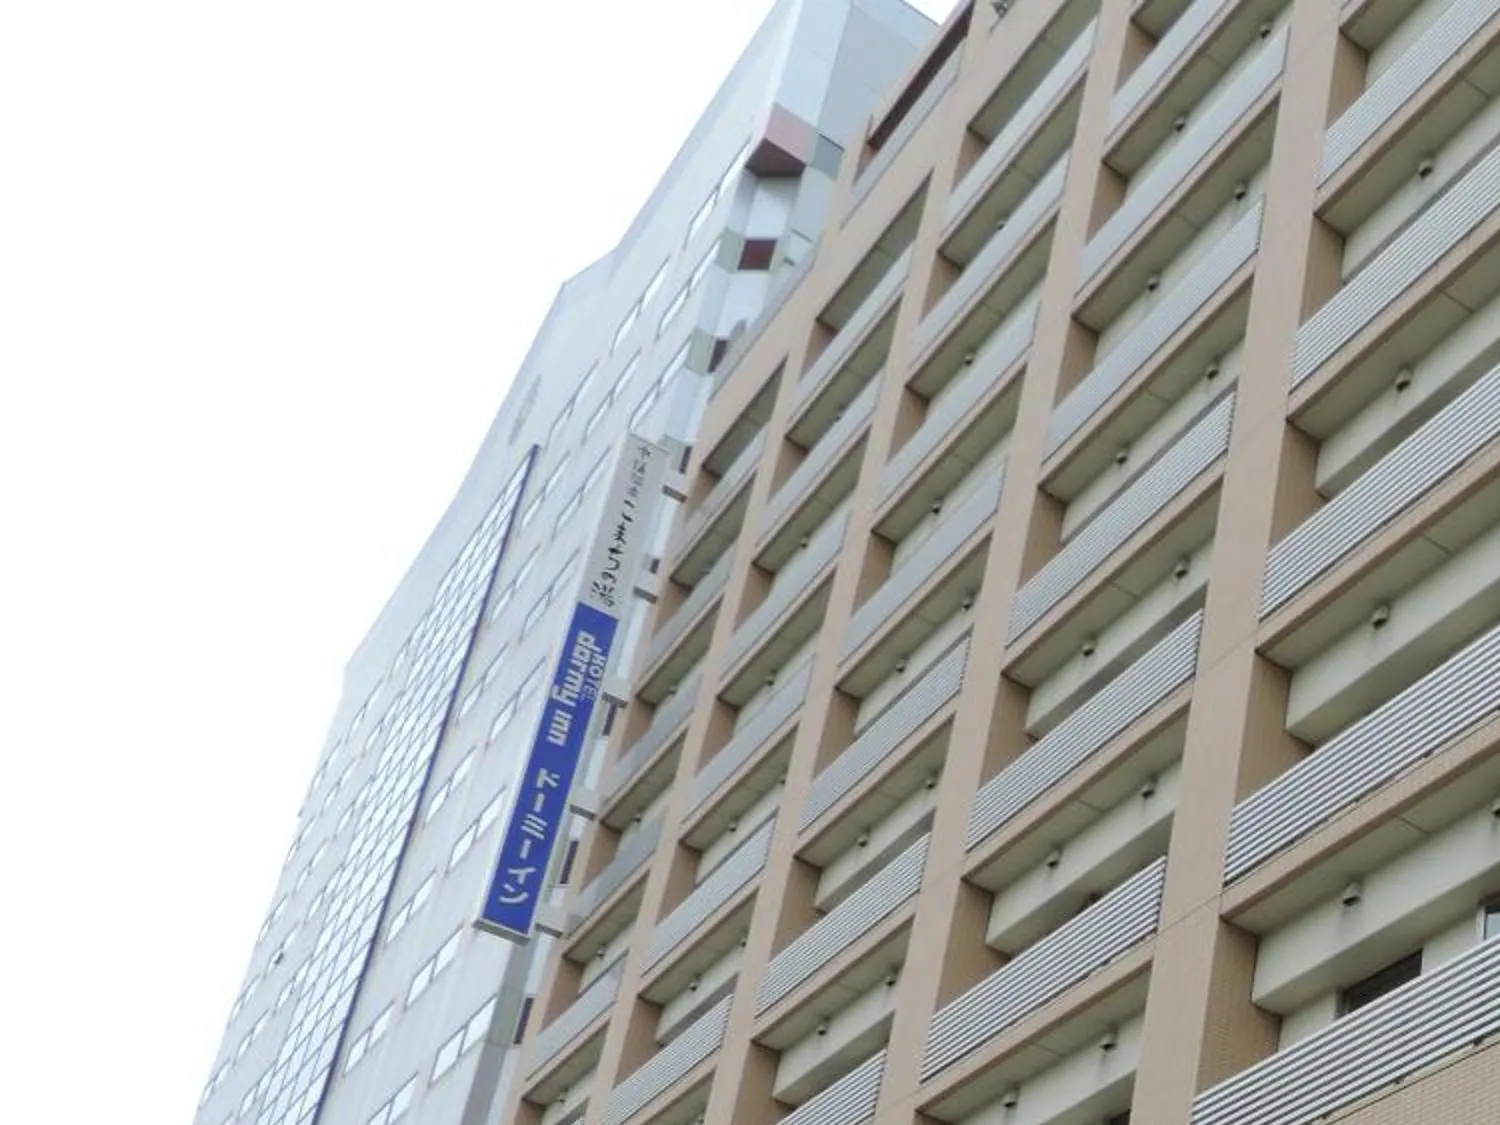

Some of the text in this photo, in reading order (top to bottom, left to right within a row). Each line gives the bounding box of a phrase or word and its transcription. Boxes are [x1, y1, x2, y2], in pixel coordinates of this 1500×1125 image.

[547, 630, 601, 746] dormy inn
[581, 652, 607, 702] HOTEL
[499, 768, 560, 904] ドーミーイン
